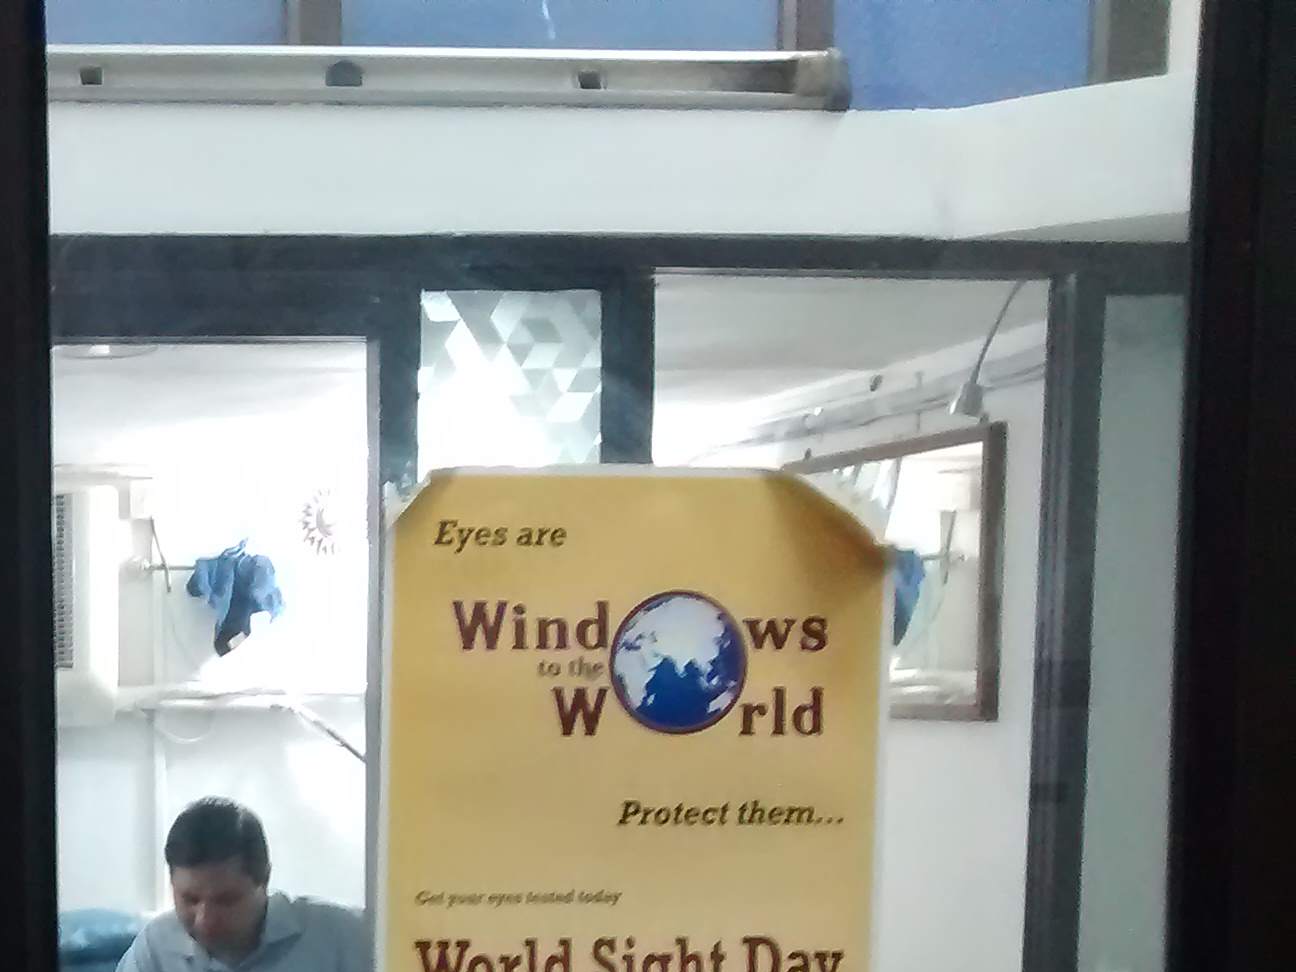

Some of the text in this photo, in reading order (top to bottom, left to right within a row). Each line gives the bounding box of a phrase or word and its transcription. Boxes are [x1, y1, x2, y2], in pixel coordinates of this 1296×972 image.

[433, 520, 568, 553] Eyes are
[538, 657, 604, 680] to the
[616, 800, 846, 827] Protect them...
[447, 892, 484, 908] your
[487, 892, 523, 908] eyes
[525, 889, 575, 905] tested
[578, 889, 623, 906] today
